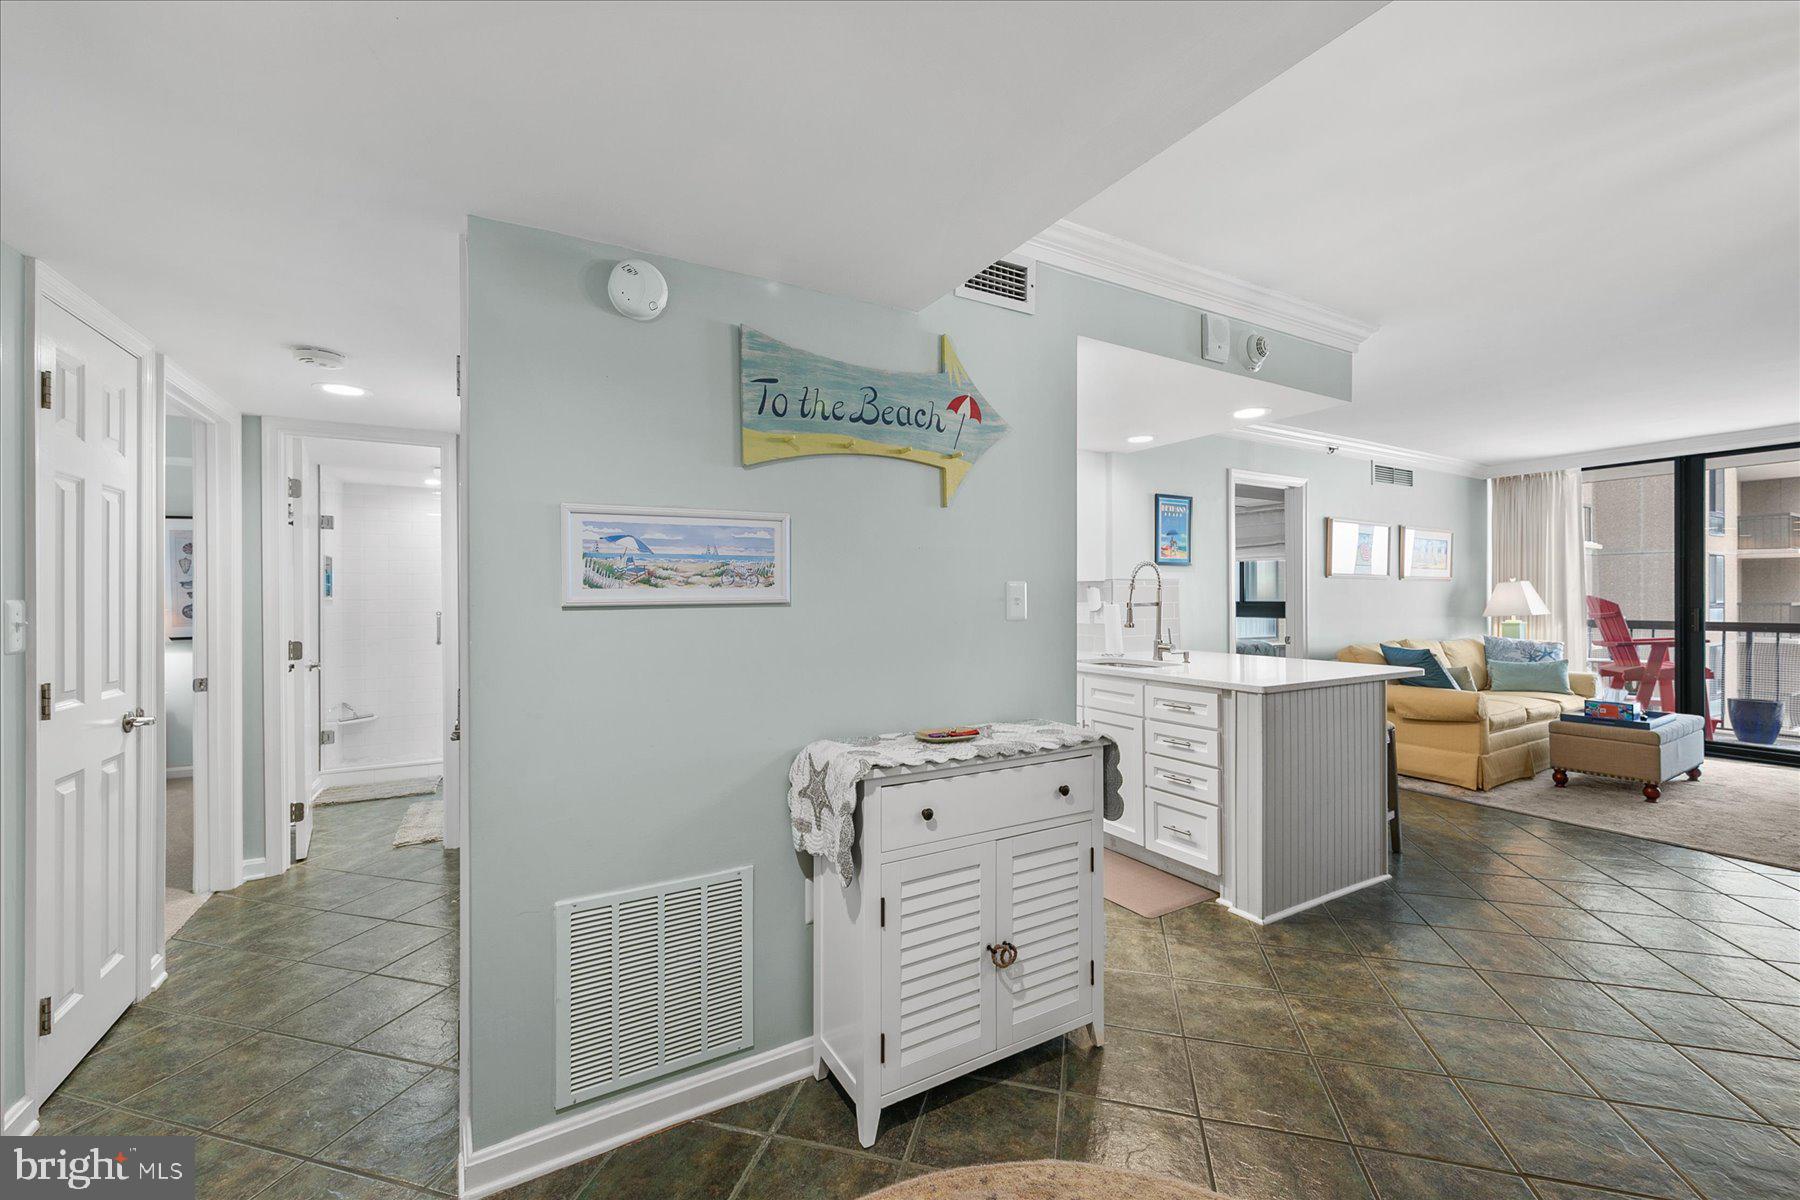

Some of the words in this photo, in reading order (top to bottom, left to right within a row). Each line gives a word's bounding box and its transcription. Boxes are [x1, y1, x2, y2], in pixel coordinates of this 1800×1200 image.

[750, 378, 788, 417] To
[798, 386, 845, 420] the
[849, 386, 946, 433] Beach
